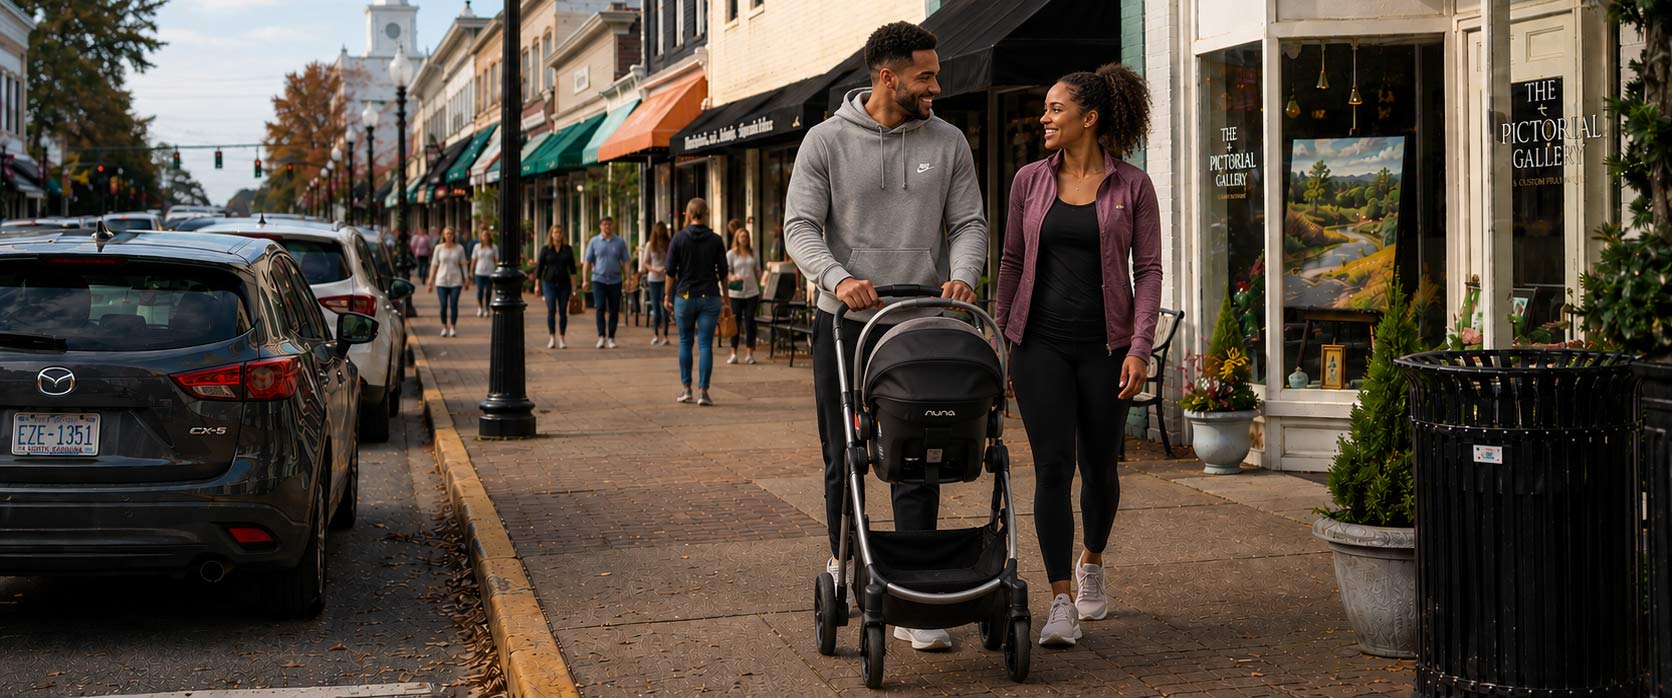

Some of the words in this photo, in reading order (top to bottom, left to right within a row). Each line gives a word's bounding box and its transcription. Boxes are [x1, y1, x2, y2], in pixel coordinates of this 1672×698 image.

[1524, 79, 1557, 103] THE
[1220, 126, 1238, 142] THE
[1501, 114, 1602, 145] PICTORIAL
[1209, 152, 1257, 172] PICTORIAL
[1512, 143, 1586, 169] GALLERY
[1215, 172, 1248, 188] GALLERY
[1518, 177, 1545, 187] CUSTOM
[18, 424, 93, 446] EZE-1351
[190, 426, 227, 435] CX-5
